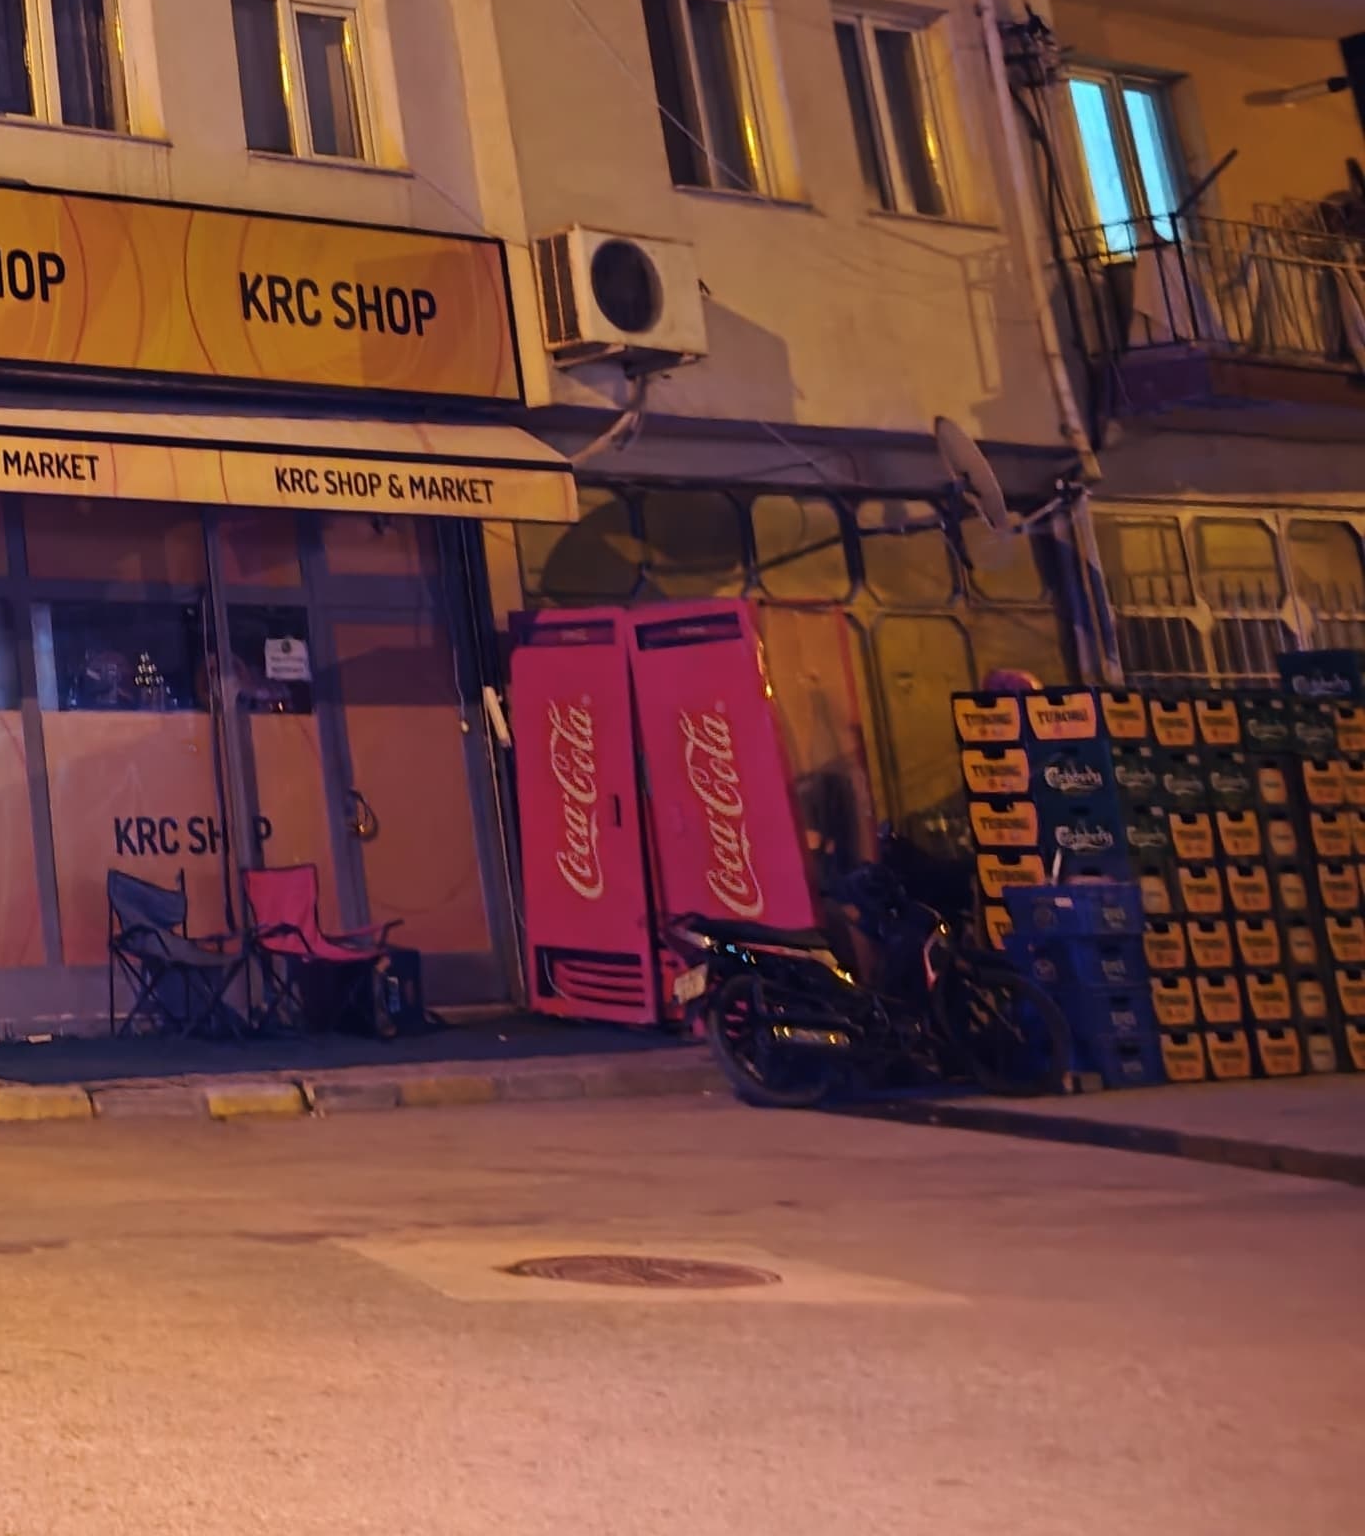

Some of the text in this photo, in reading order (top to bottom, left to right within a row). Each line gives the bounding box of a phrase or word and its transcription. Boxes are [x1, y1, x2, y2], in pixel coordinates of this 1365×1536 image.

[239, 271, 437, 337] KRC SHOP
[2, 449, 100, 481] MARKET
[274, 466, 495, 505] KRC SHOP & MARKET
[548, 699, 604, 900] Coca-Cola
[679, 708, 763, 917] Coca-Cola
[114, 815, 273, 856] KRC SHP
